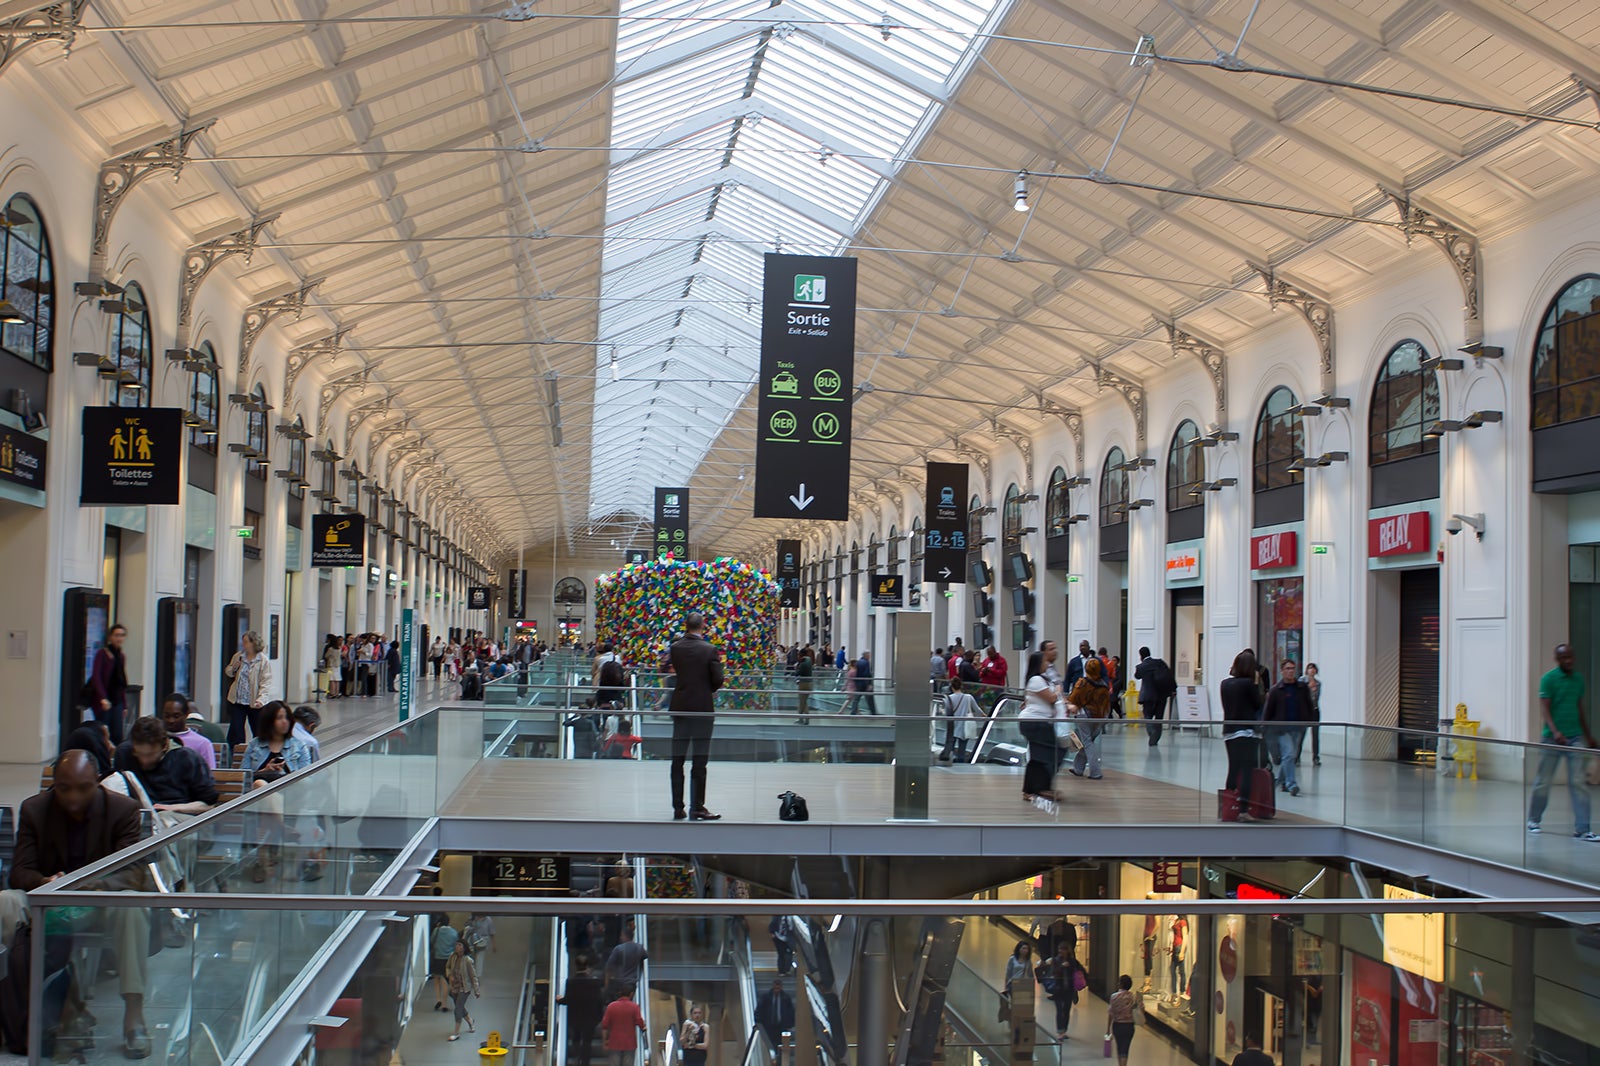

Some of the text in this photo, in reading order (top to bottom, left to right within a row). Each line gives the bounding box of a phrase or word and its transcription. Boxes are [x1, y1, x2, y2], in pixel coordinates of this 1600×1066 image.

[787, 311, 830, 326] Sortie
[777, 361, 795, 369] Taxis
[817, 377, 837, 388] BUS
[124, 417, 140, 425] WC
[773, 418, 793, 429] RER
[818, 418, 833, 433] M
[109, 468, 153, 479] Toilettes
[1379, 514, 1409, 553] RELAY
[927, 534, 942, 546] 12
[951, 535, 965, 547] 15
[1258, 533, 1280, 566] RELAY
[495, 863, 515, 878] 12
[537, 864, 557, 878] 15
